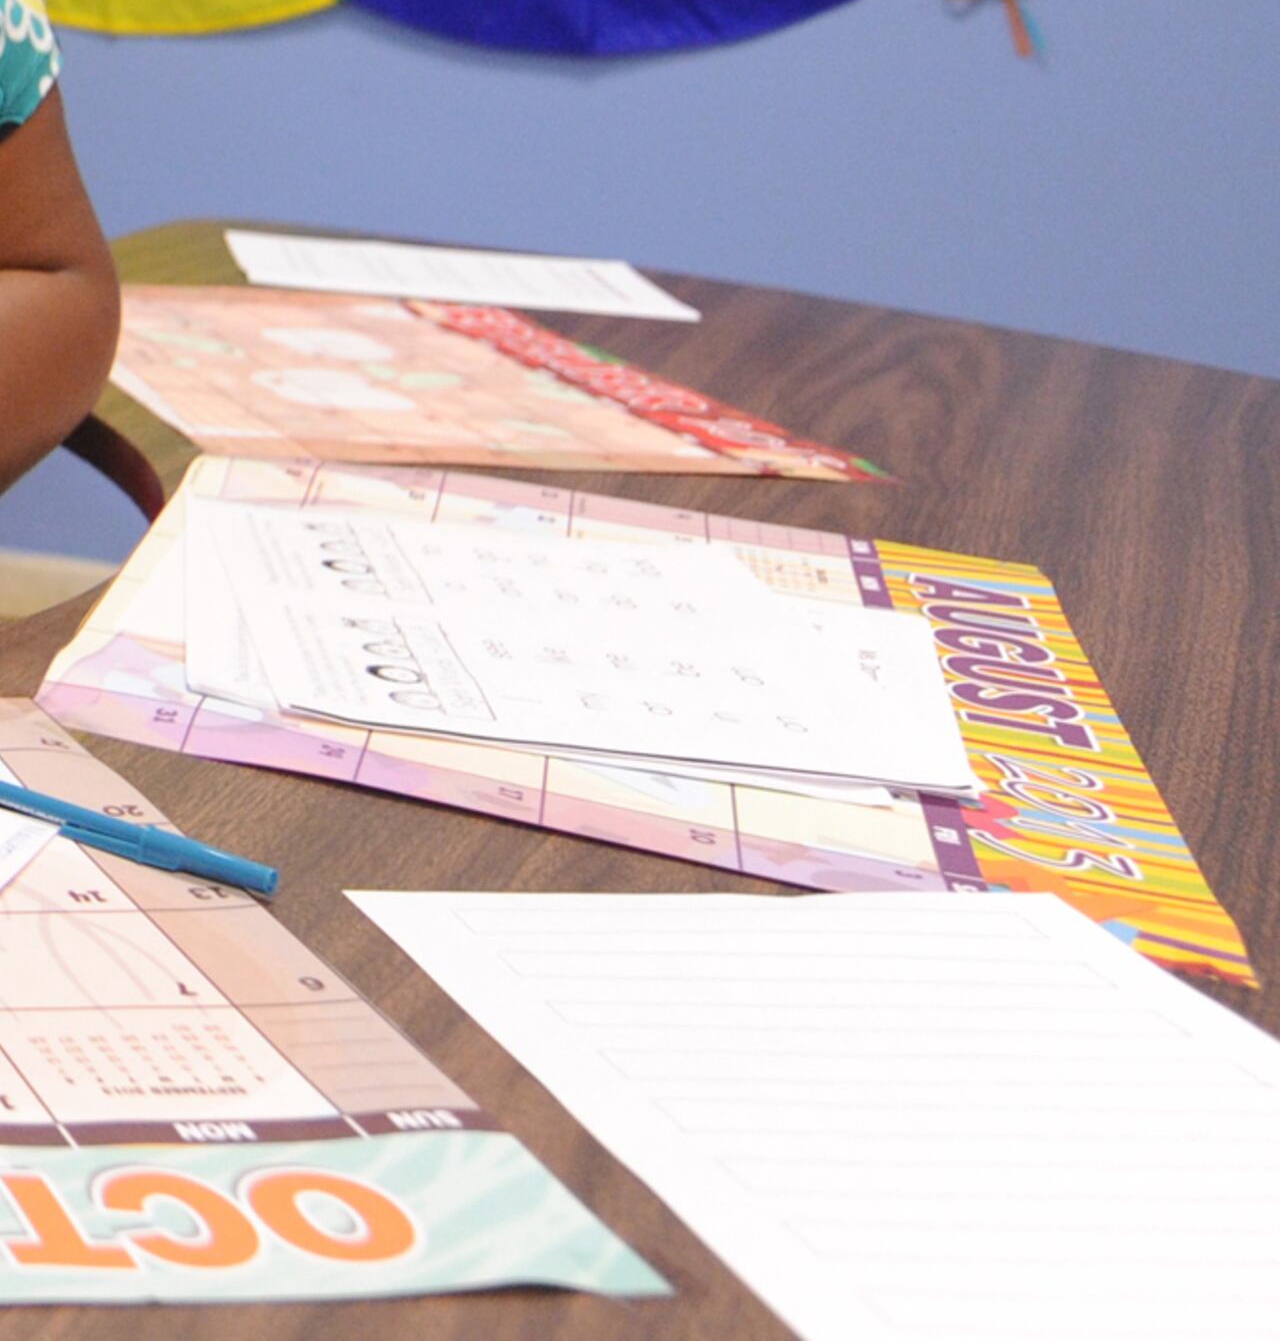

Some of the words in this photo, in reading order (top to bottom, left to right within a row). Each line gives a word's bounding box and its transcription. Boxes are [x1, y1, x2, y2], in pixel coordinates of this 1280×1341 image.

[908, 569, 1104, 754] AUGUST
[100, 803, 146, 818] 20
[964, 751, 1146, 882] 2013
[689, 826, 717, 847] 10
[67, 889, 108, 905] 14
[176, 981, 199, 997] 7
[299, 976, 326, 993] 6
[385, 1107, 464, 1130] SUN
[171, 1118, 259, 1142] MON
